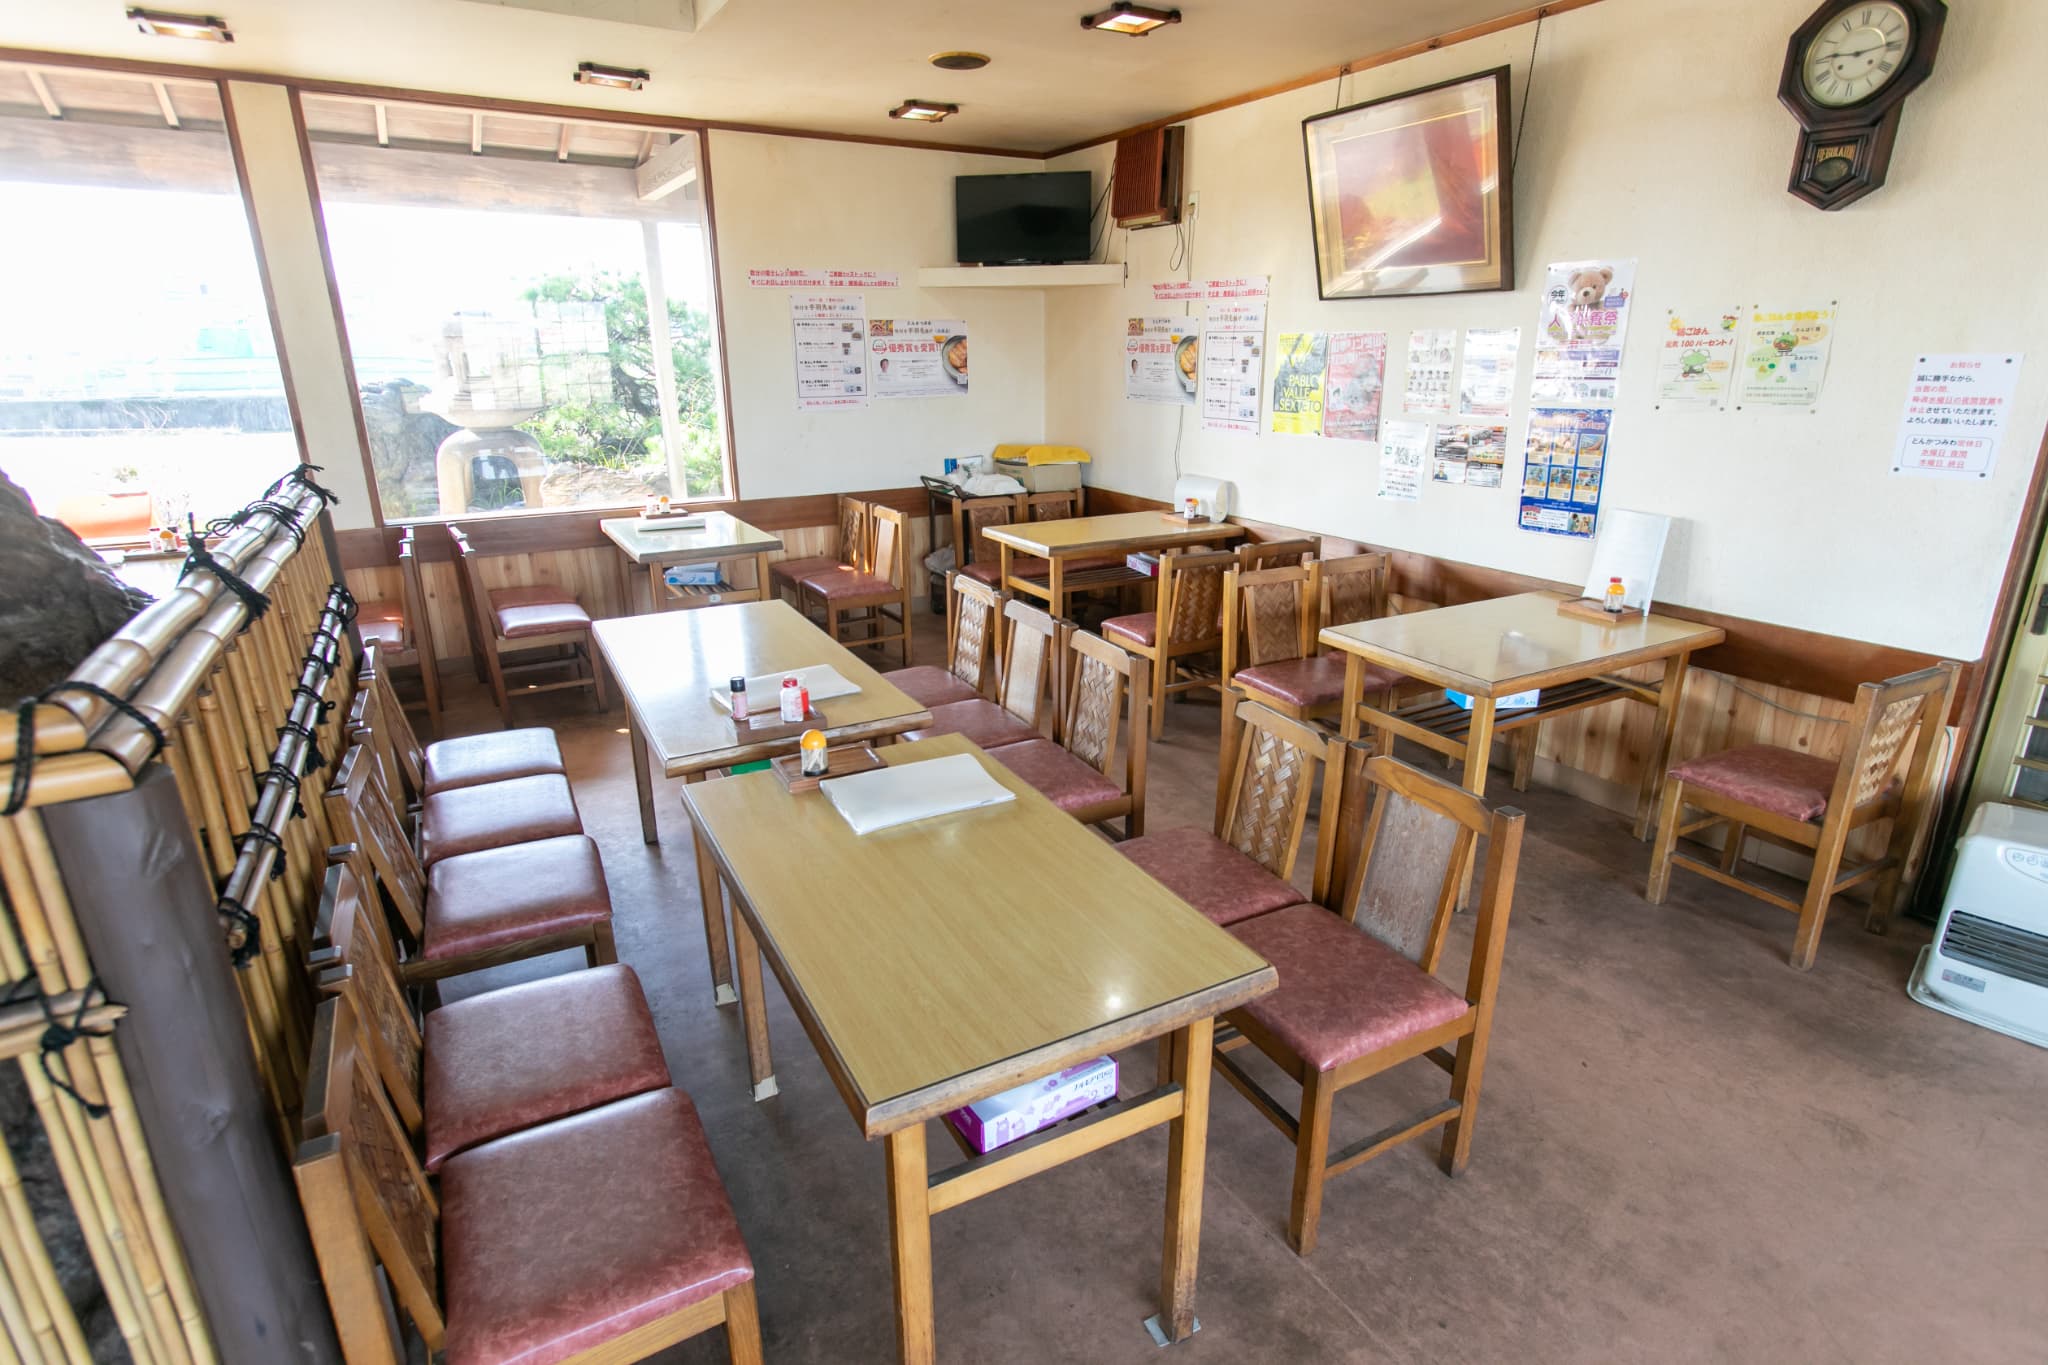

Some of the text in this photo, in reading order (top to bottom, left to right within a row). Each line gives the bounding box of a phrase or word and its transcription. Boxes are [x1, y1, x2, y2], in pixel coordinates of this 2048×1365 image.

[1289, 374, 1319, 387] PABLO
[1281, 387, 1310, 398] VALLE
[1279, 399, 1322, 413] SEXTETO
